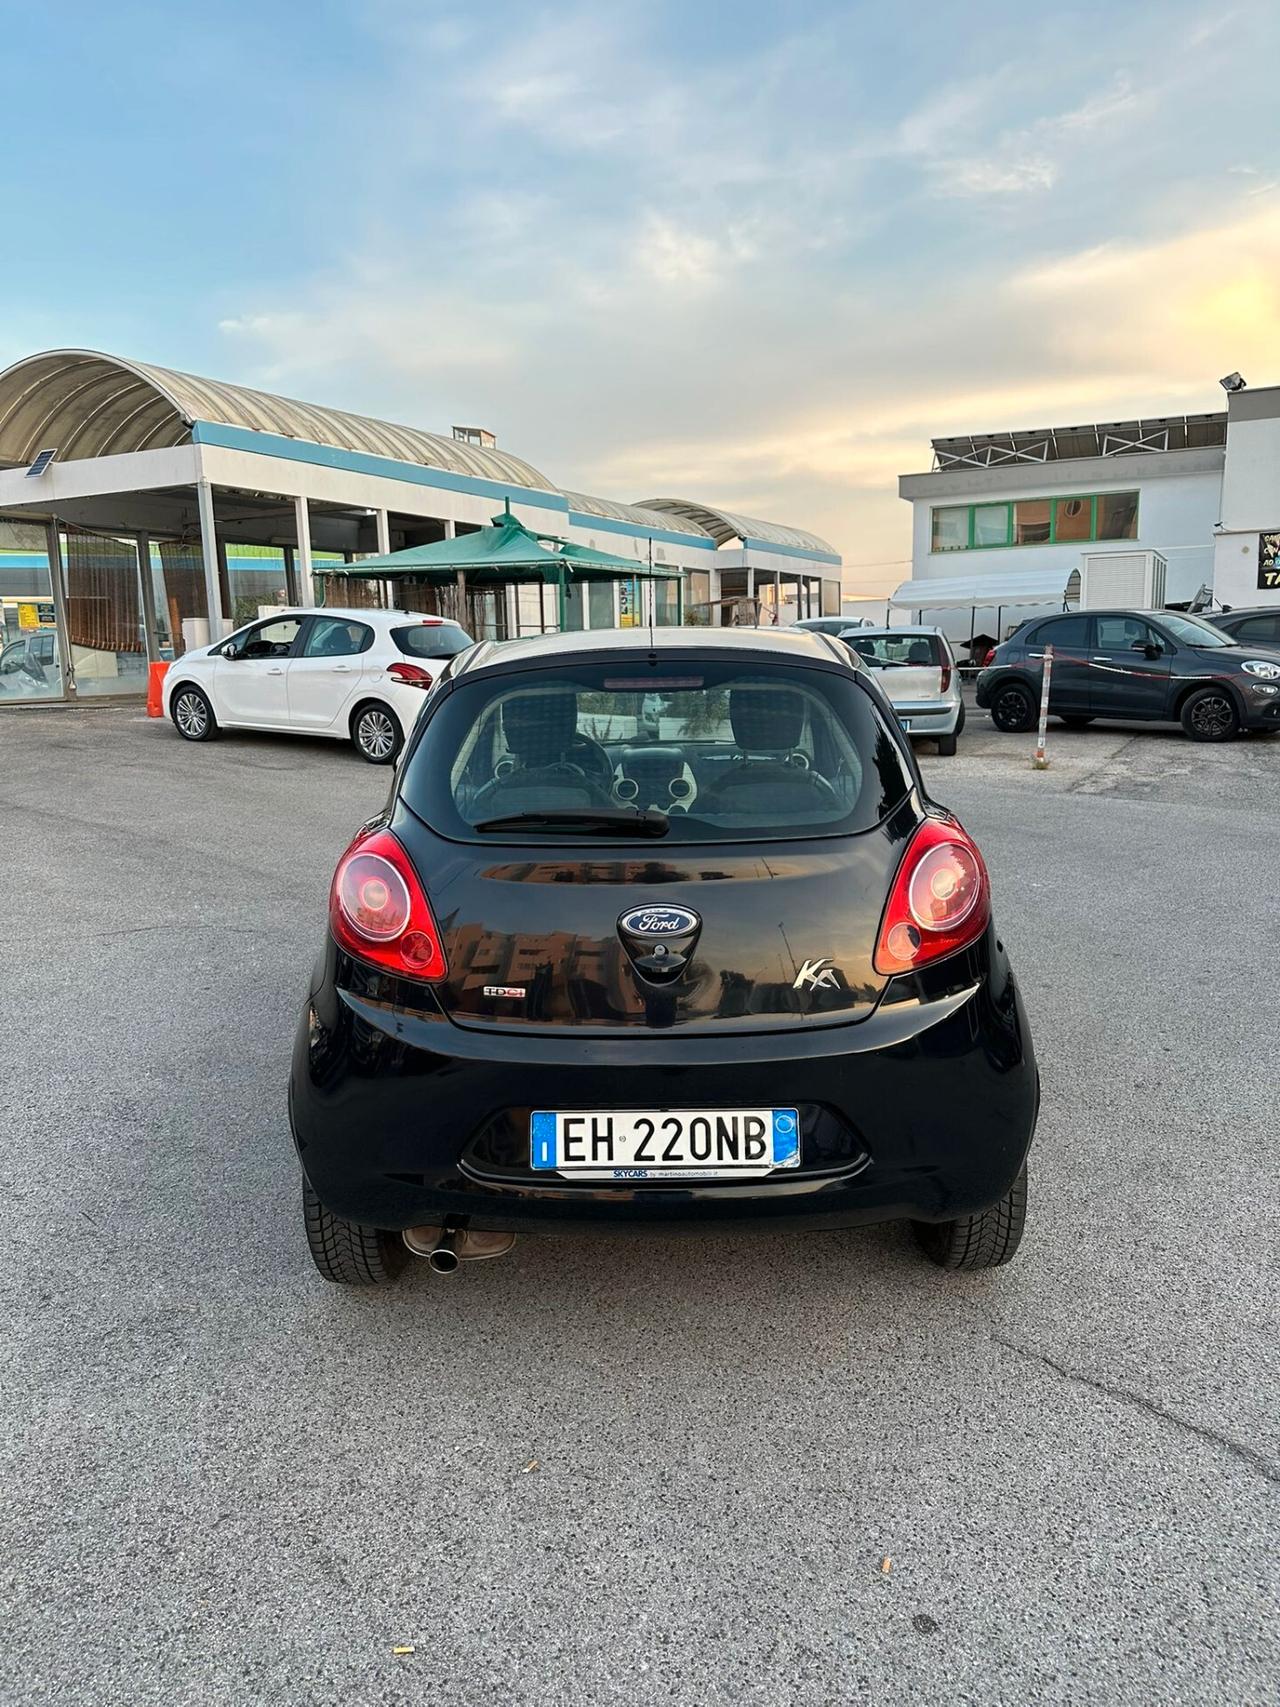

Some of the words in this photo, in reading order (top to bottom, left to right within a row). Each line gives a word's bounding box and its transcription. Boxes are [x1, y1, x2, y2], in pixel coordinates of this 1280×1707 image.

[638, 913, 680, 931] Ford
[563, 1117, 614, 1162] EH
[632, 1115, 767, 1162] 220NB
[613, 1169, 648, 1178] SKYCARS
